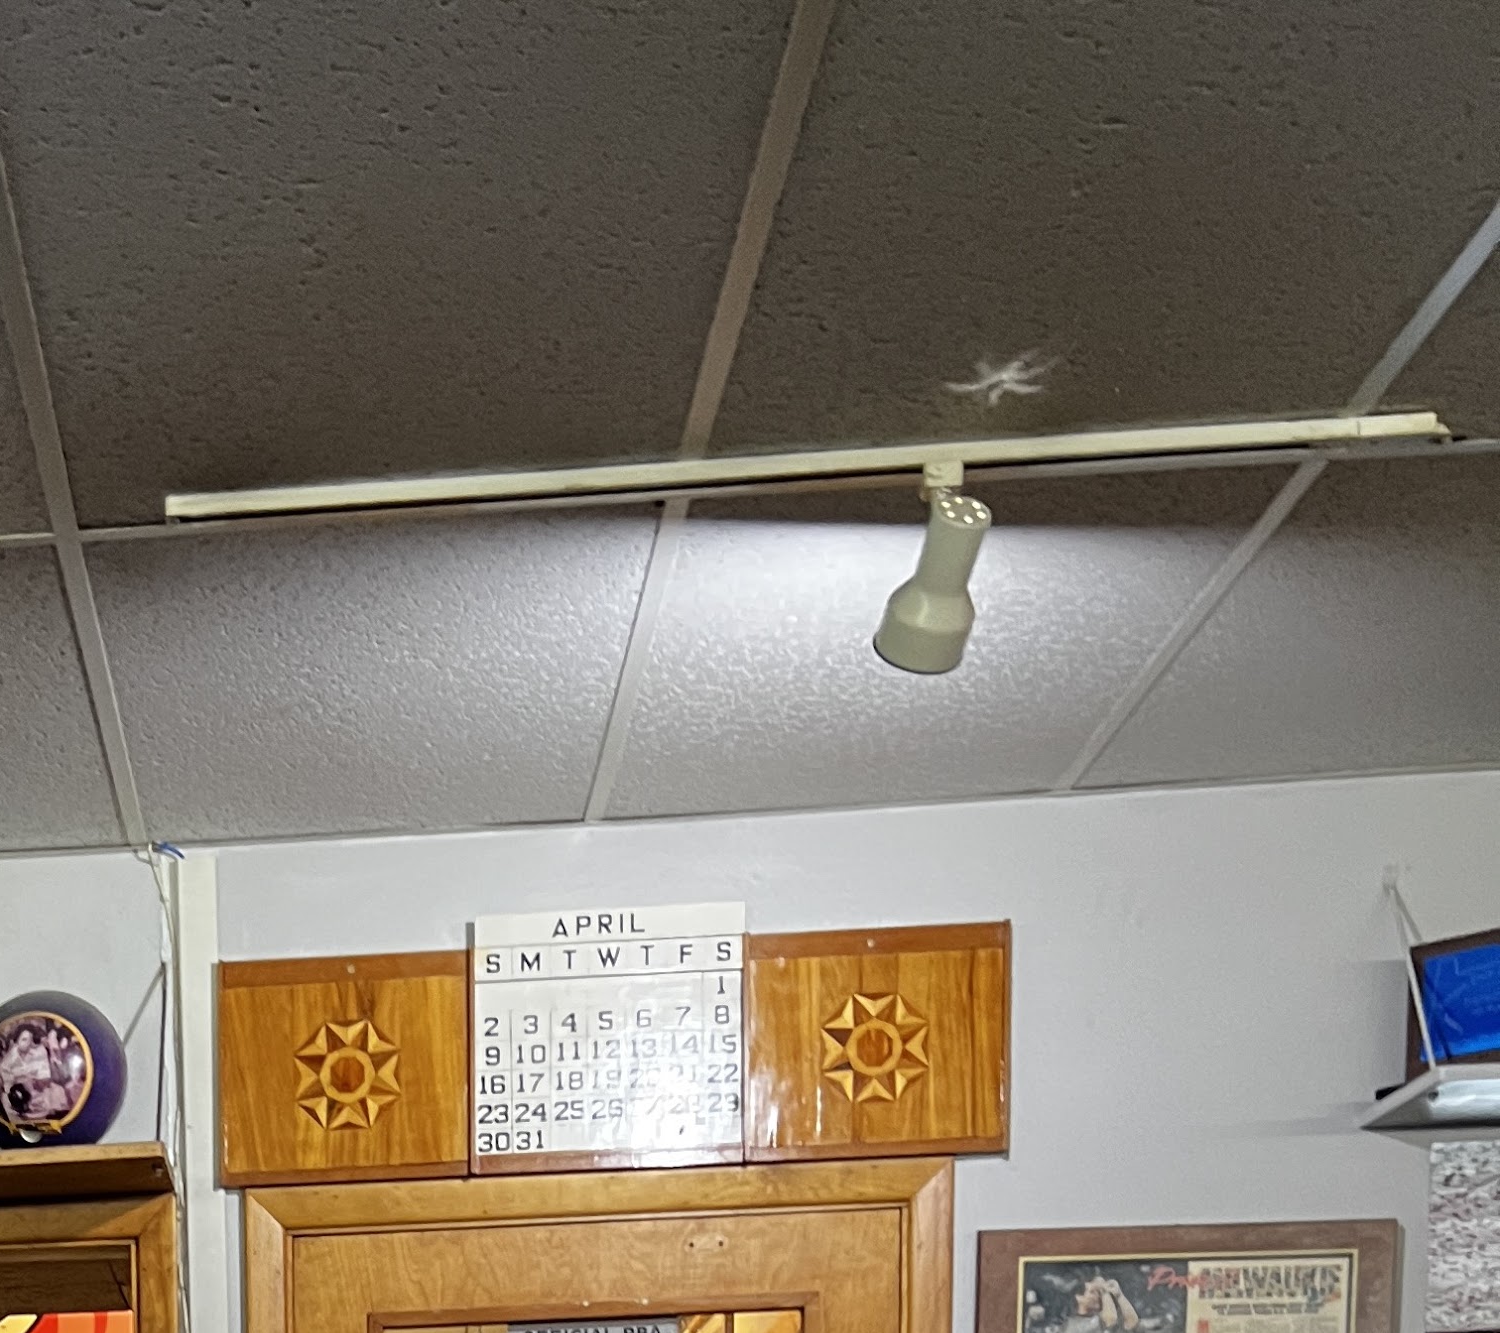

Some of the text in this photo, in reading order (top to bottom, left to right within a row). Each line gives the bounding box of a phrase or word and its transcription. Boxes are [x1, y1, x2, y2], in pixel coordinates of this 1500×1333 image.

[553, 913, 645, 938] APRIL
[486, 942, 731, 973] S M T W T F S
[717, 975, 726, 995] 1
[484, 1005, 729, 1037] 2 3 4 5 6 7 8
[485, 1034, 737, 1066] 9 10 11 12 13 14 15
[480, 1075, 505, 1095] 16
[518, 1073, 544, 1093] 17
[556, 1071, 583, 1091] 18
[708, 1064, 738, 1084] 22
[478, 1104, 509, 1125] 23
[515, 1103, 547, 1123] 24
[554, 1100, 584, 1121] 25
[592, 1099, 623, 1120] 26
[478, 1130, 544, 1152] 30 31
